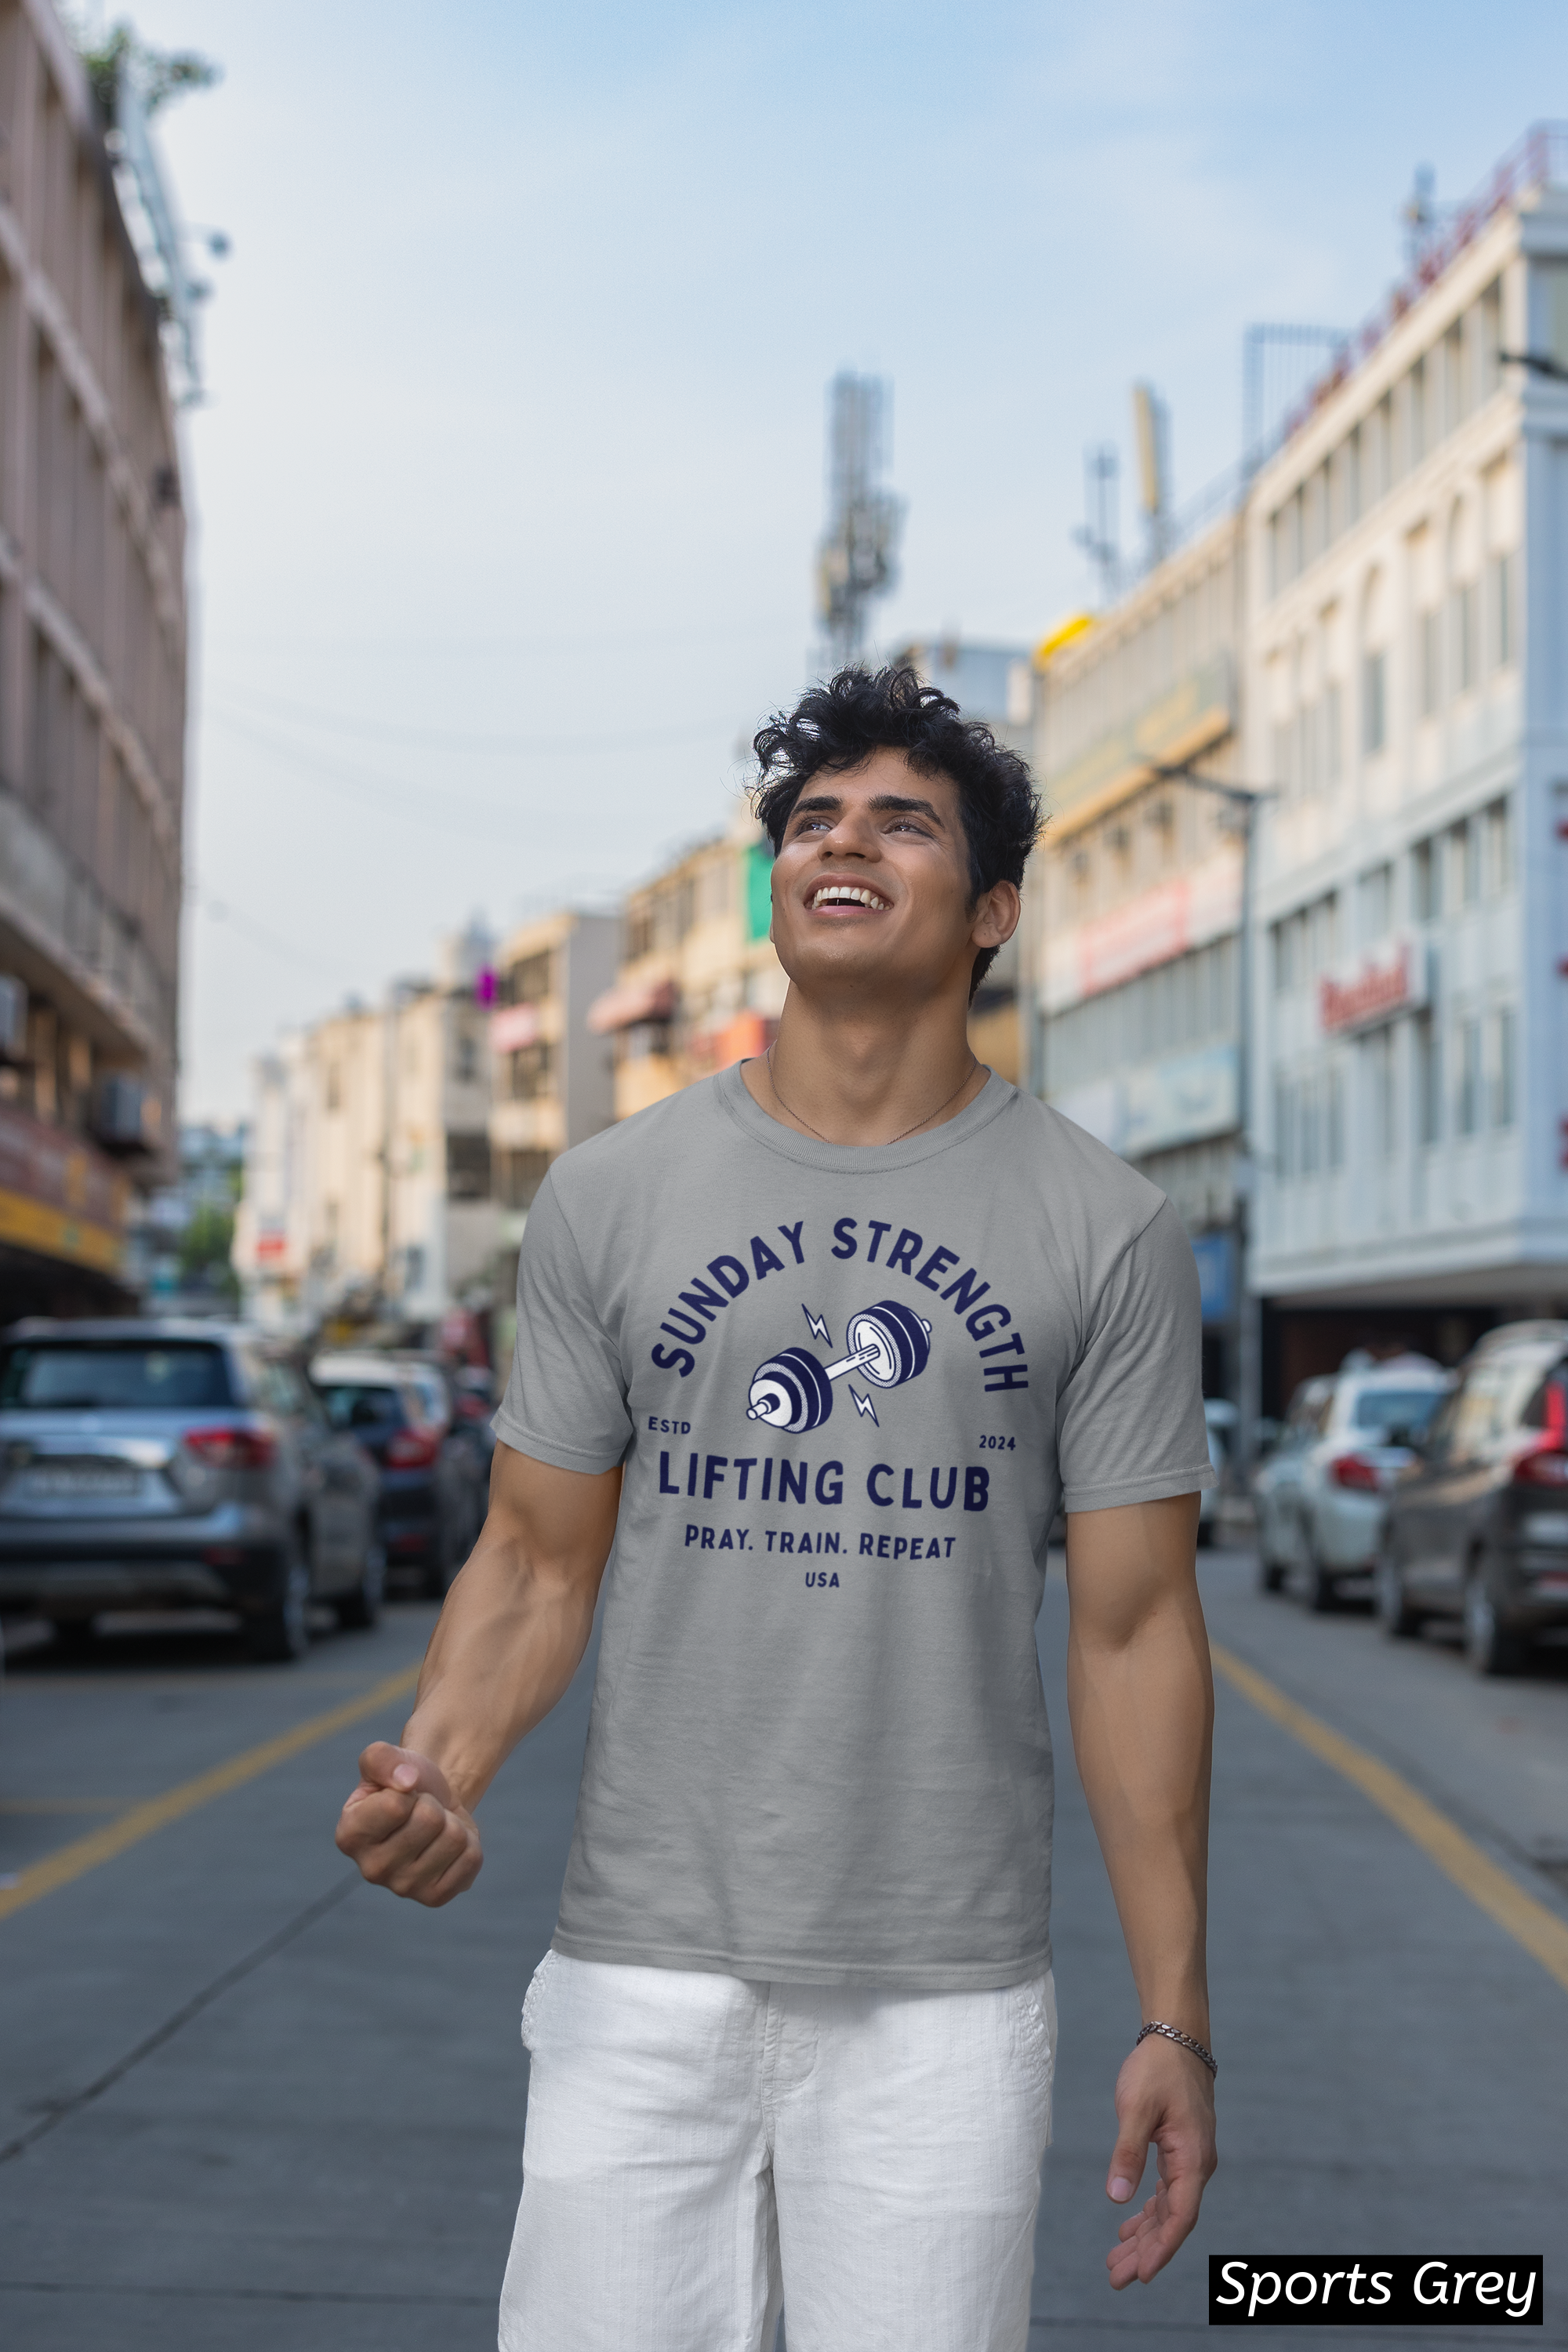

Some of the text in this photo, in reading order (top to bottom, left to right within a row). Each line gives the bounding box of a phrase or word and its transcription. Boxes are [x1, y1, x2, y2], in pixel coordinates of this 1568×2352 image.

[651, 1217, 1029, 1392] SUNDAY STRENGTH
[648, 1415, 691, 1435] ESTD
[978, 1434, 1016, 1451] 2024
[659, 1450, 990, 1512] LIFTING CLUB
[684, 1523, 956, 1560] PRAY. TRAIN. REPEAT
[805, 1571, 840, 1588] USA
